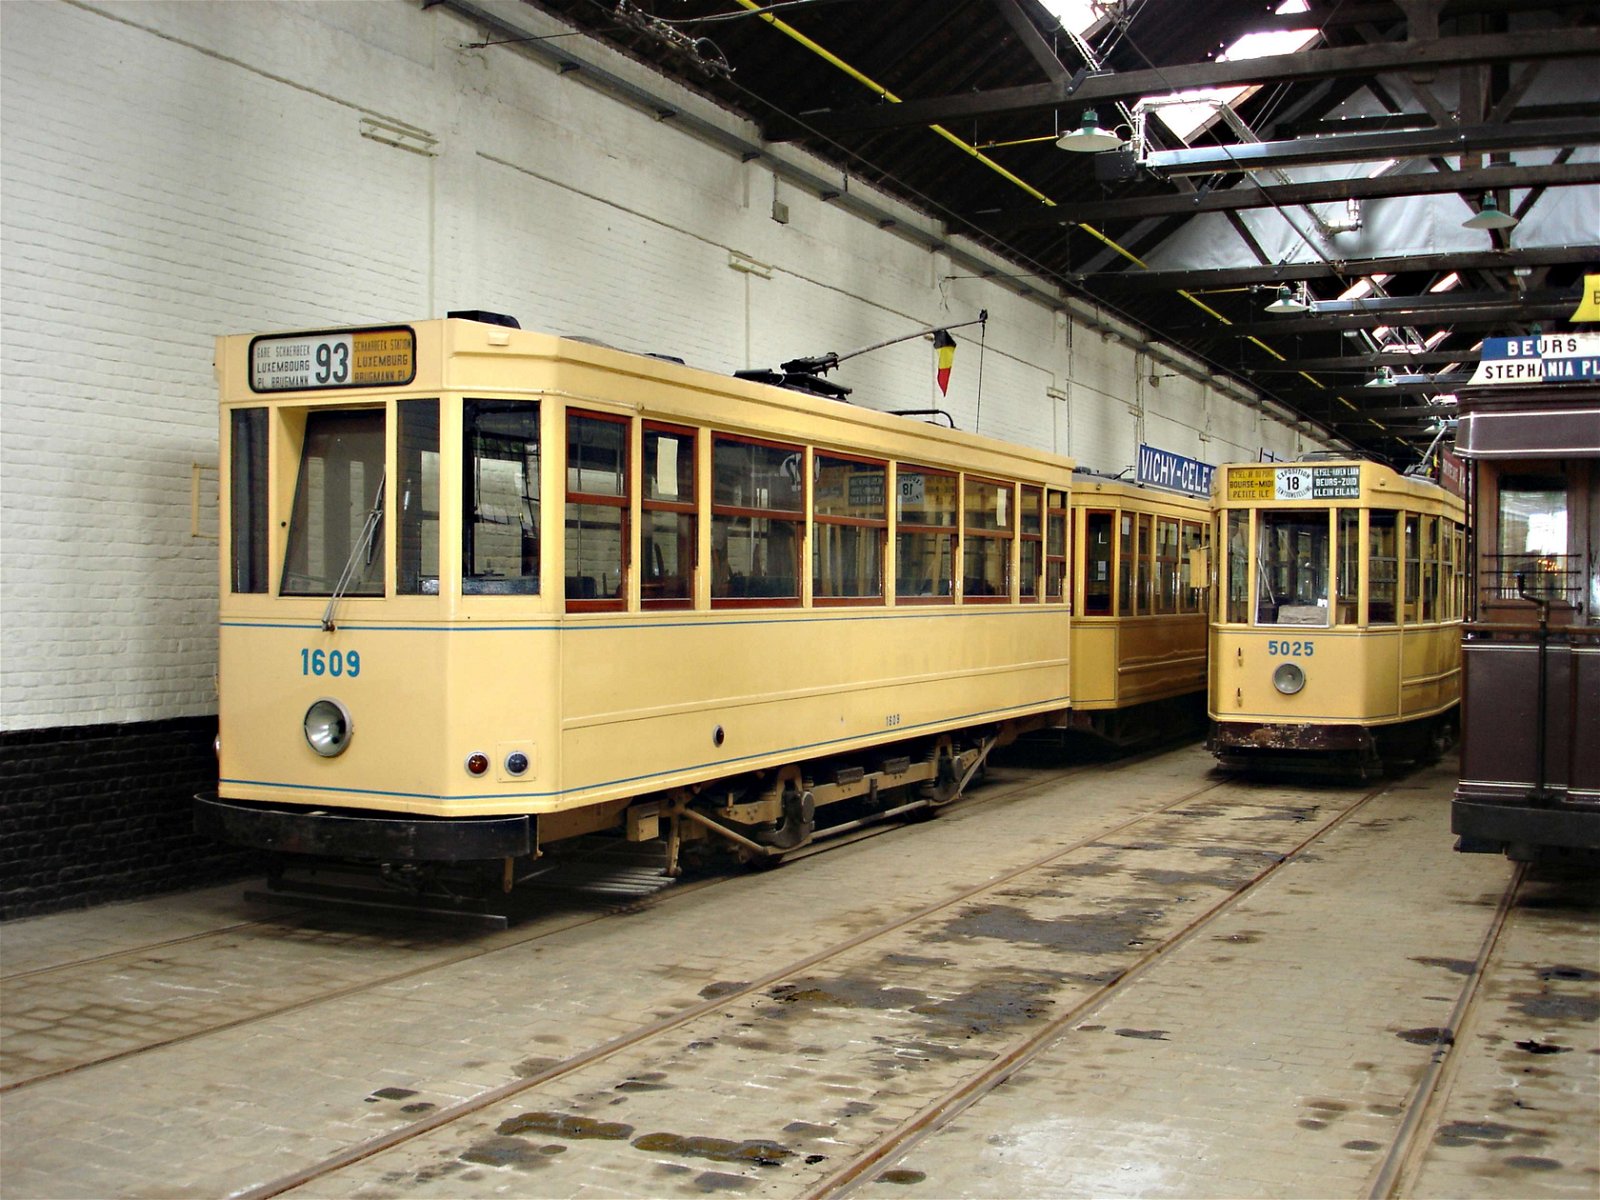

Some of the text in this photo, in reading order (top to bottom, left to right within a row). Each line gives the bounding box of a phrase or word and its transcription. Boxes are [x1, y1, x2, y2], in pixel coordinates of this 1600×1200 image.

[1507, 339, 1577, 356] BEURS
[257, 360, 310, 373] LUXEMBOURG
[315, 342, 349, 384] 93
[357, 354, 408, 368] LUXEMBURG
[1485, 361, 1574, 379] STEPHANIA
[1276, 468, 1311, 480] EXPOSITION
[1229, 480, 1273, 488] BOURSE-MIDI
[1286, 476, 1300, 491] 18
[1315, 478, 1357, 486] BEURS-ZUID
[1232, 490, 1256, 498] PETITE
[1314, 487, 1359, 496] KLEIN EILAND
[1268, 640, 1314, 656] 5025
[301, 648, 360, 677] 1609
[886, 713, 900, 726] 1609
